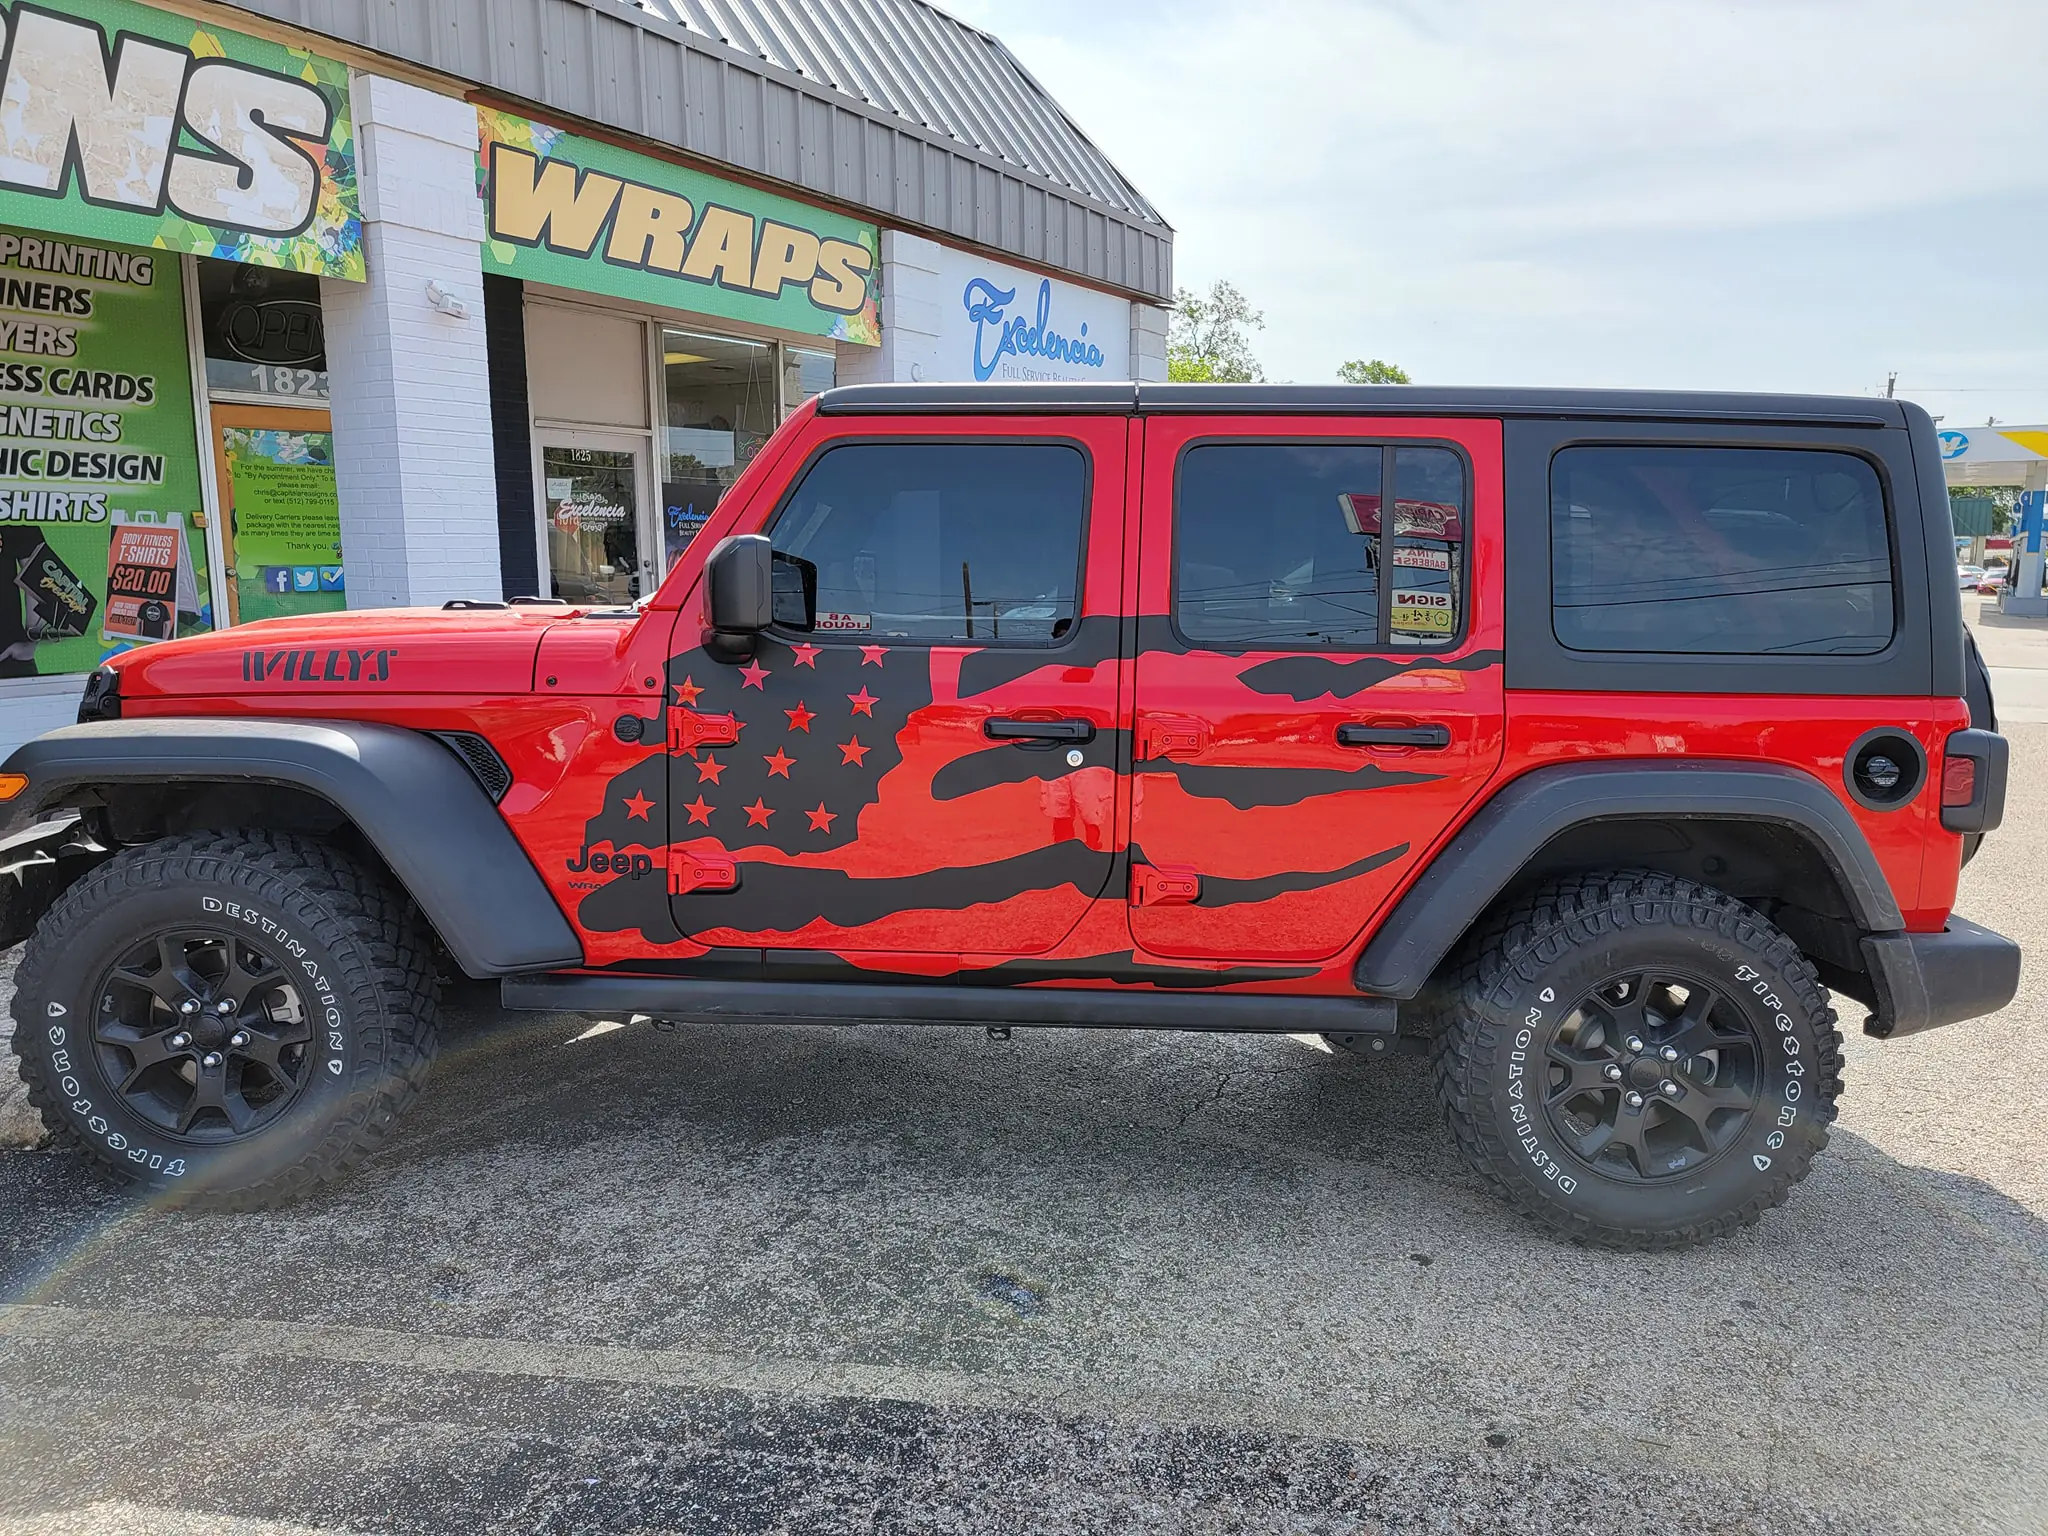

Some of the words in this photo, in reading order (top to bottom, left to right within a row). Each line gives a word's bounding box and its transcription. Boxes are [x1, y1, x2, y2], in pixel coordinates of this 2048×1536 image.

[0, 2, 332, 239] NS
[489, 141, 873, 315] WRAPS
[0, 234, 154, 285] PRINTING
[0, 278, 91, 315] NERS
[963, 277, 1104, 382] Excelencia
[49, 368, 154, 402] CARDS
[1002, 363, 1021, 380] FULL
[46, 450, 163, 482] DESIGN
[571, 448, 592, 462] 1825
[558, 498, 626, 519] Excelencia
[119, 545, 170, 566] T-SHIRTS
[122, 532, 142, 546] BODY
[142, 534, 173, 549] FITNESS
[286, 542, 310, 550] Thank
[112, 566, 171, 596] $20.00
[242, 649, 398, 682] WILLYS
[565, 844, 653, 880] Jeep
[202, 896, 345, 1051] DESTINATION
[1733, 964, 1806, 1150] Firestone
[47, 1024, 187, 1177] Firestone
[1507, 1006, 1578, 1196] DESTINATION
